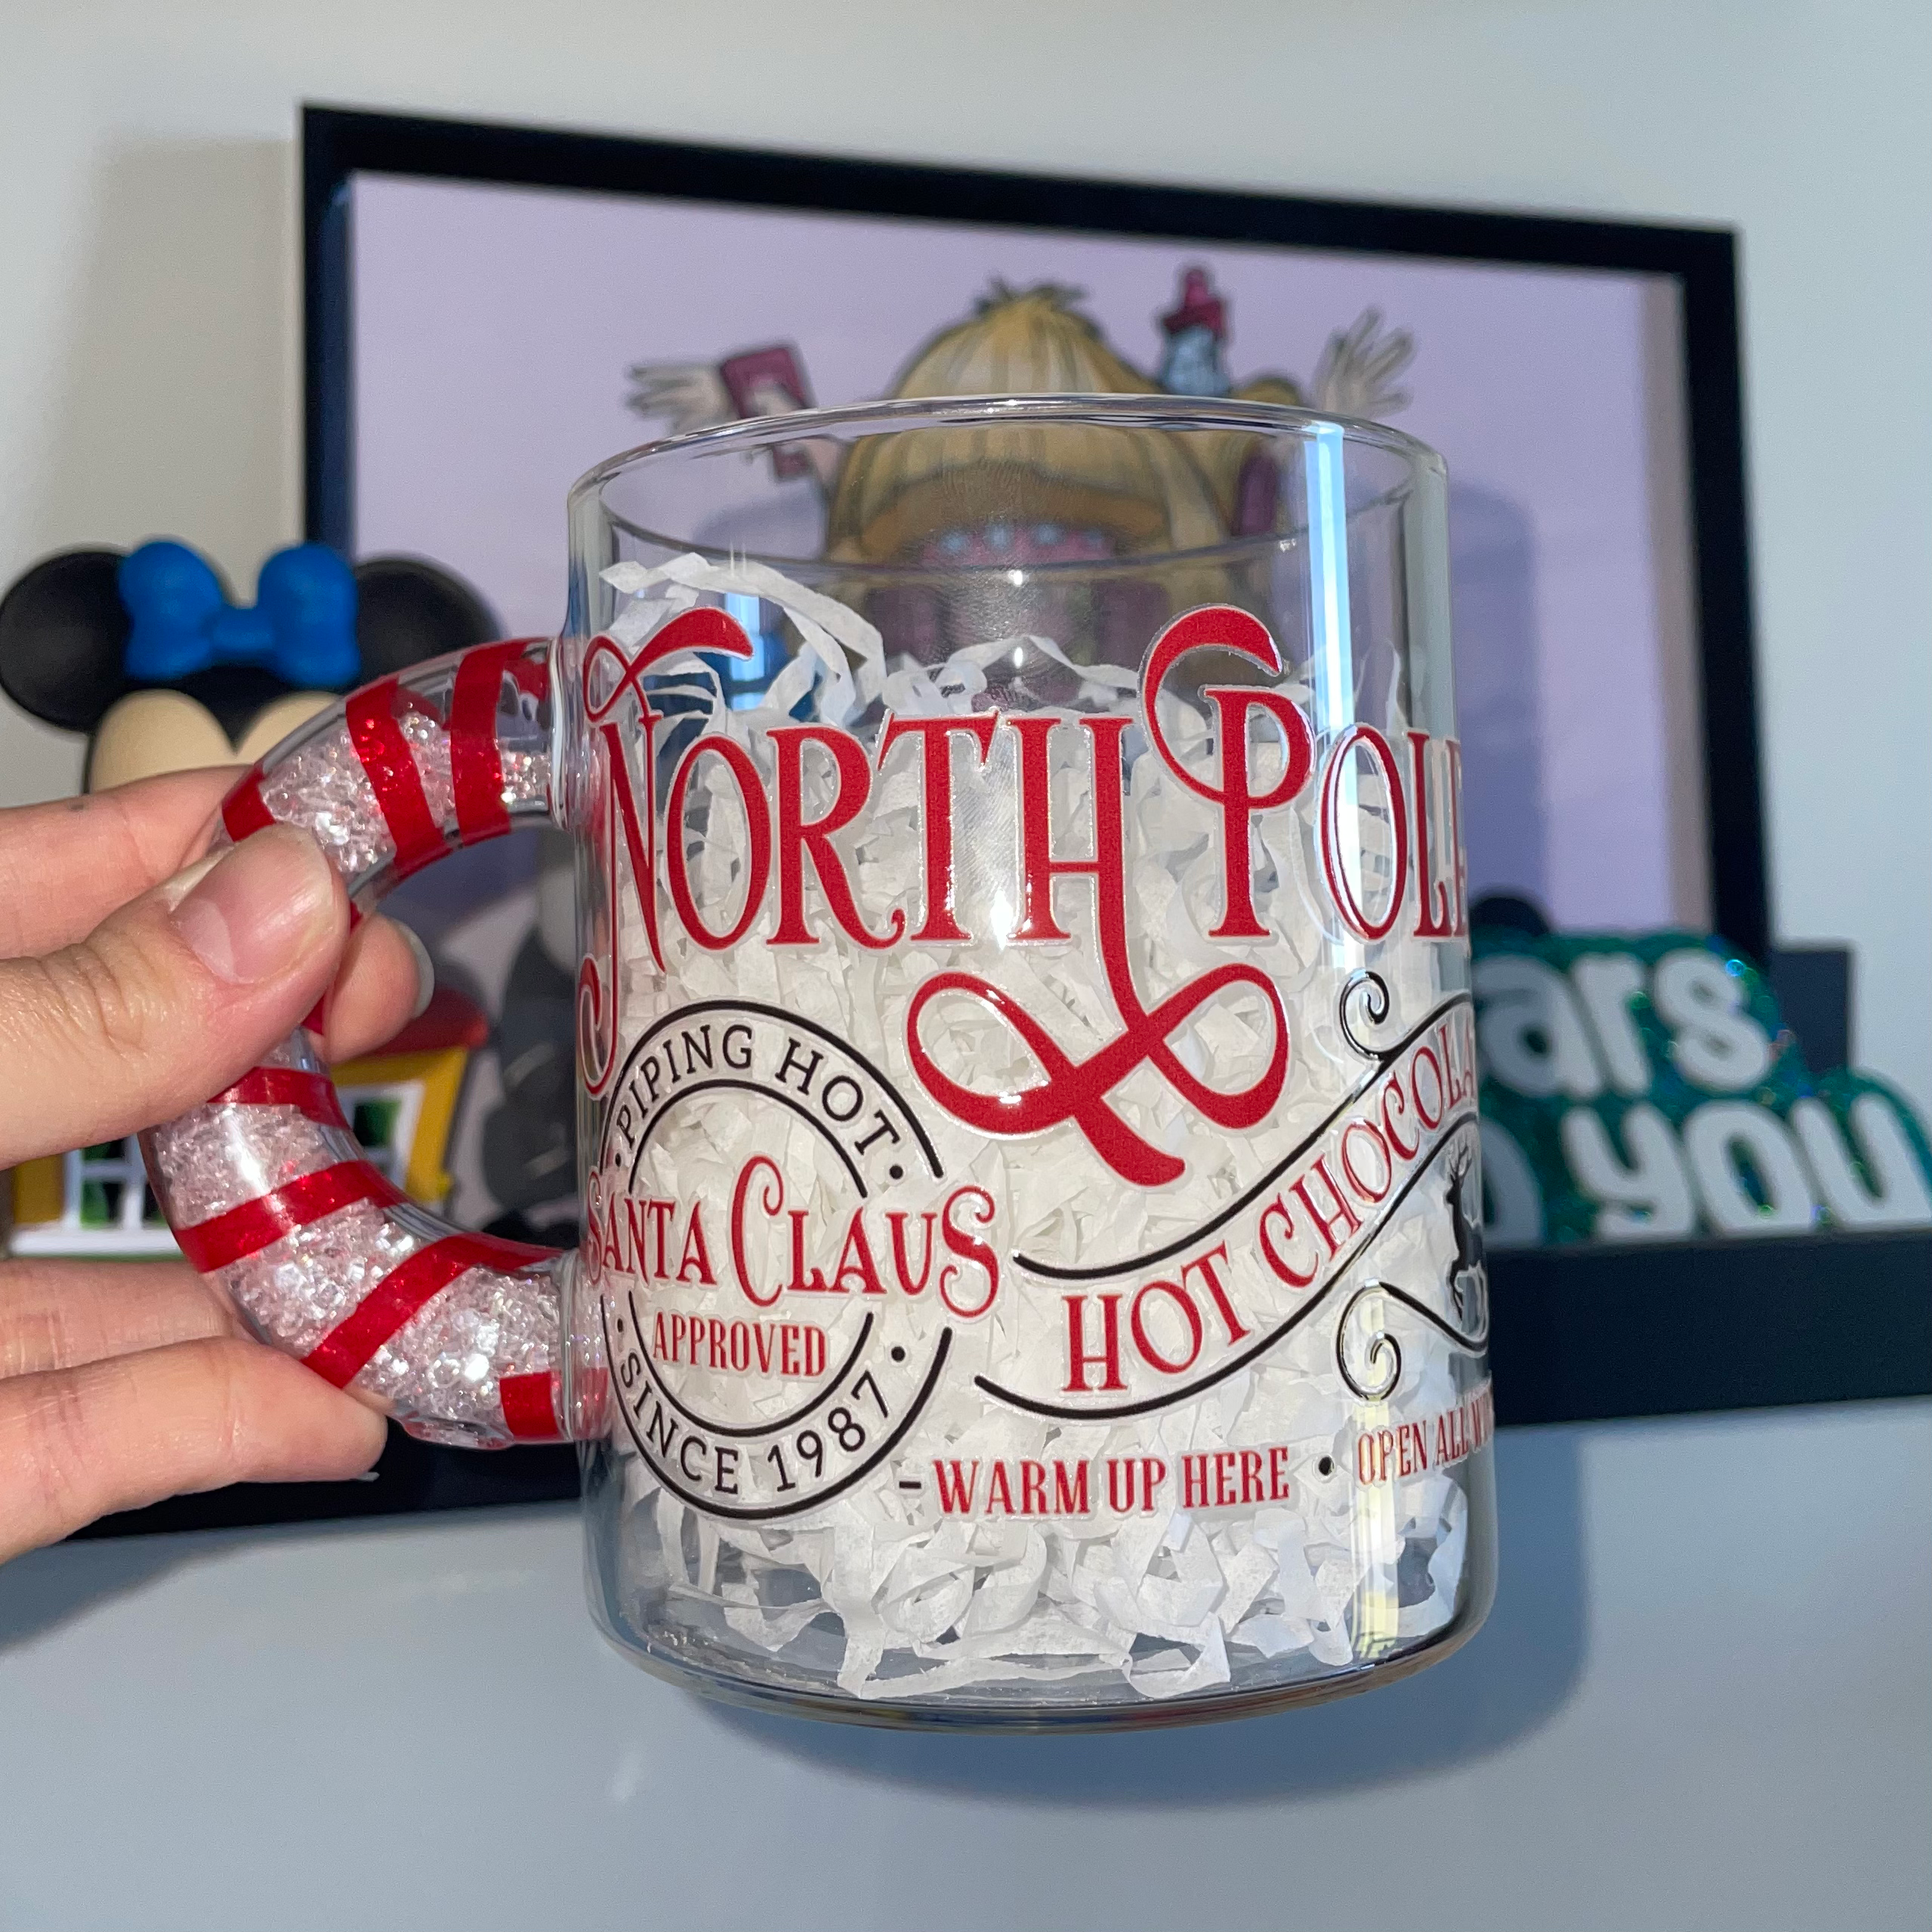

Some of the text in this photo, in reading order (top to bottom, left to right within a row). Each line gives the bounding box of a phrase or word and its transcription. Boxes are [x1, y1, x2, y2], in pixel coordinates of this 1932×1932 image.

[617, 1024, 902, 1156] PIPING HOT
[1560, 1094, 1932, 1240] you
[588, 1156, 999, 1319] SANTA CLAUS
[653, 1311, 828, 1378] APPROVED
[1060, 1240, 1251, 1393] HOT
[619, 1353, 890, 1495] SINCE 1987
[933, 1446, 1289, 1516] WARM UP HERE
[1357, 1420, 1427, 1486] OPEN
[1435, 1406, 1469, 1466] ALL
